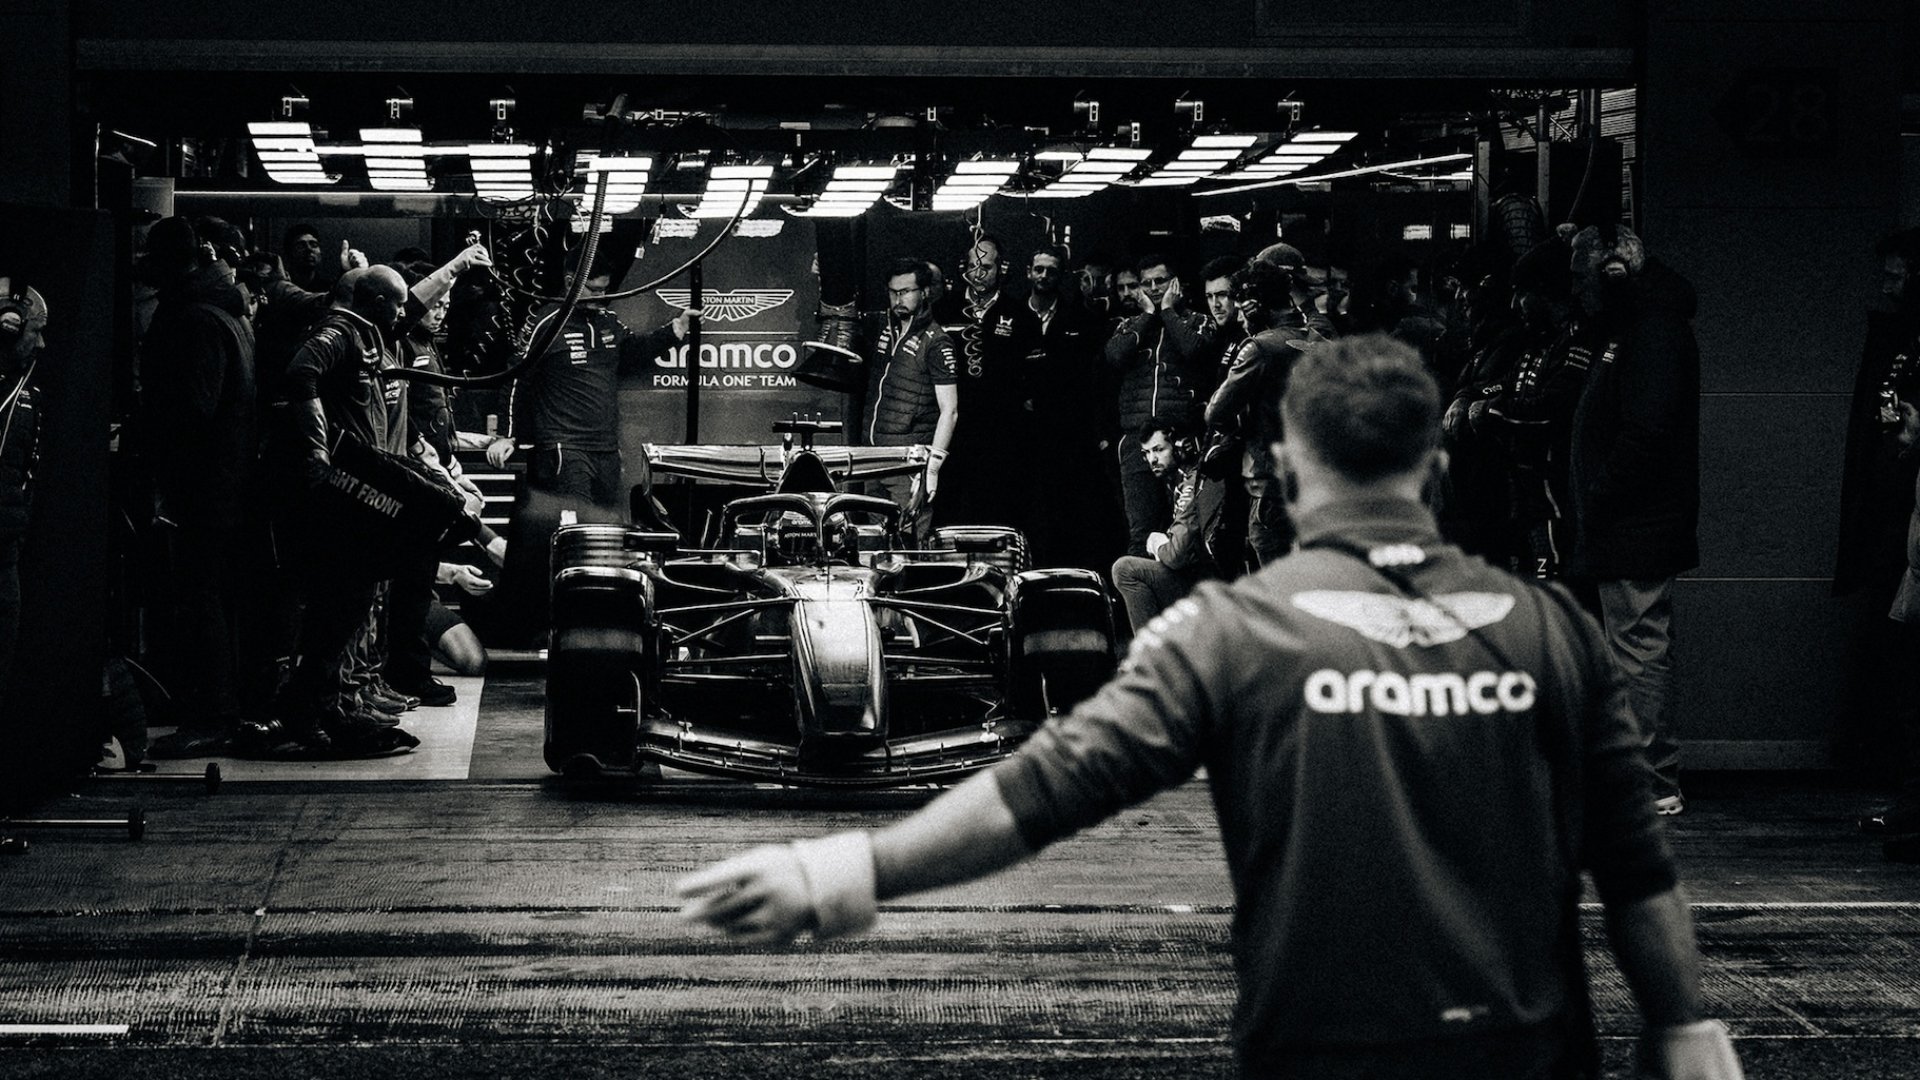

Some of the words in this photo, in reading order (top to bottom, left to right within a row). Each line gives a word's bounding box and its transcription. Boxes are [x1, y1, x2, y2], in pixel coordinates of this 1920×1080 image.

[1745, 84, 1828, 142] 28
[701, 296, 723, 304] STON
[724, 296, 754, 304] MARTIN
[759, 375, 797, 387] TEAM
[357, 483, 404, 518] FRONT
[1304, 669, 1537, 717] aramco
